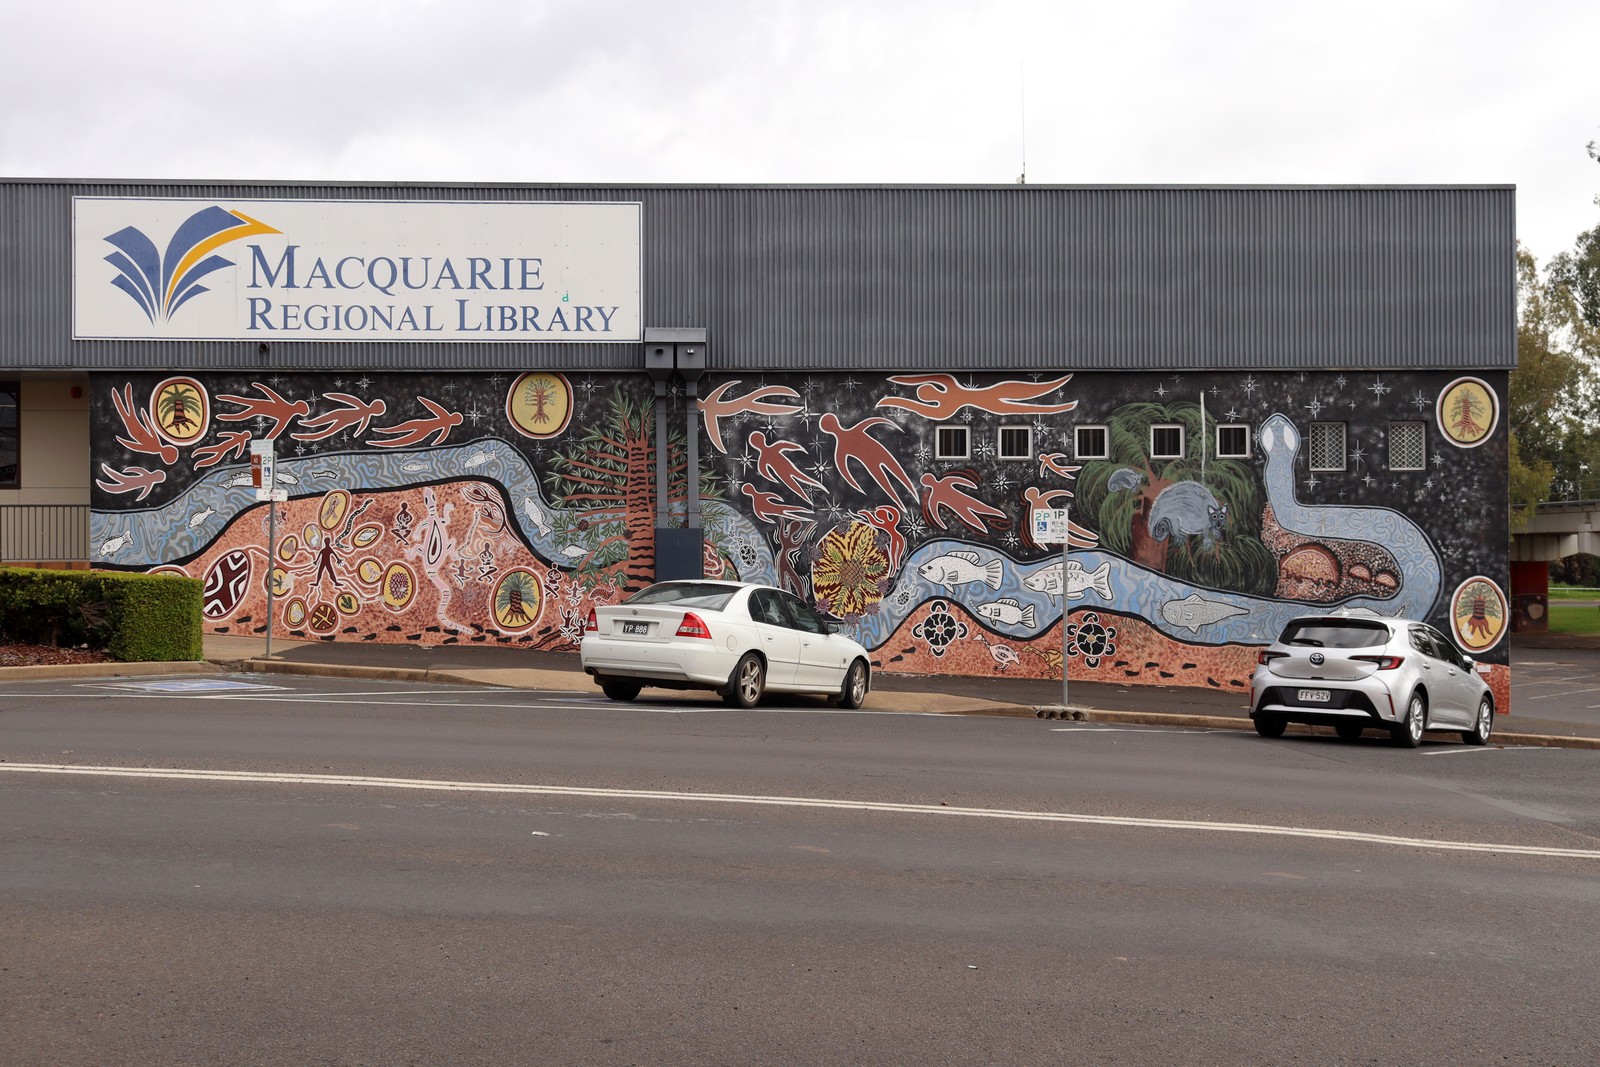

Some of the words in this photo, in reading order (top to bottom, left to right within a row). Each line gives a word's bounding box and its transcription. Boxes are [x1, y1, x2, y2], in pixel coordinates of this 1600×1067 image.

[246, 244, 544, 296] MACQUARIE
[246, 297, 444, 331] REGIONAL
[455, 299, 619, 332] LIBRARY
[262, 456, 272, 464] 2P
[1054, 511, 1065, 519] 1P
